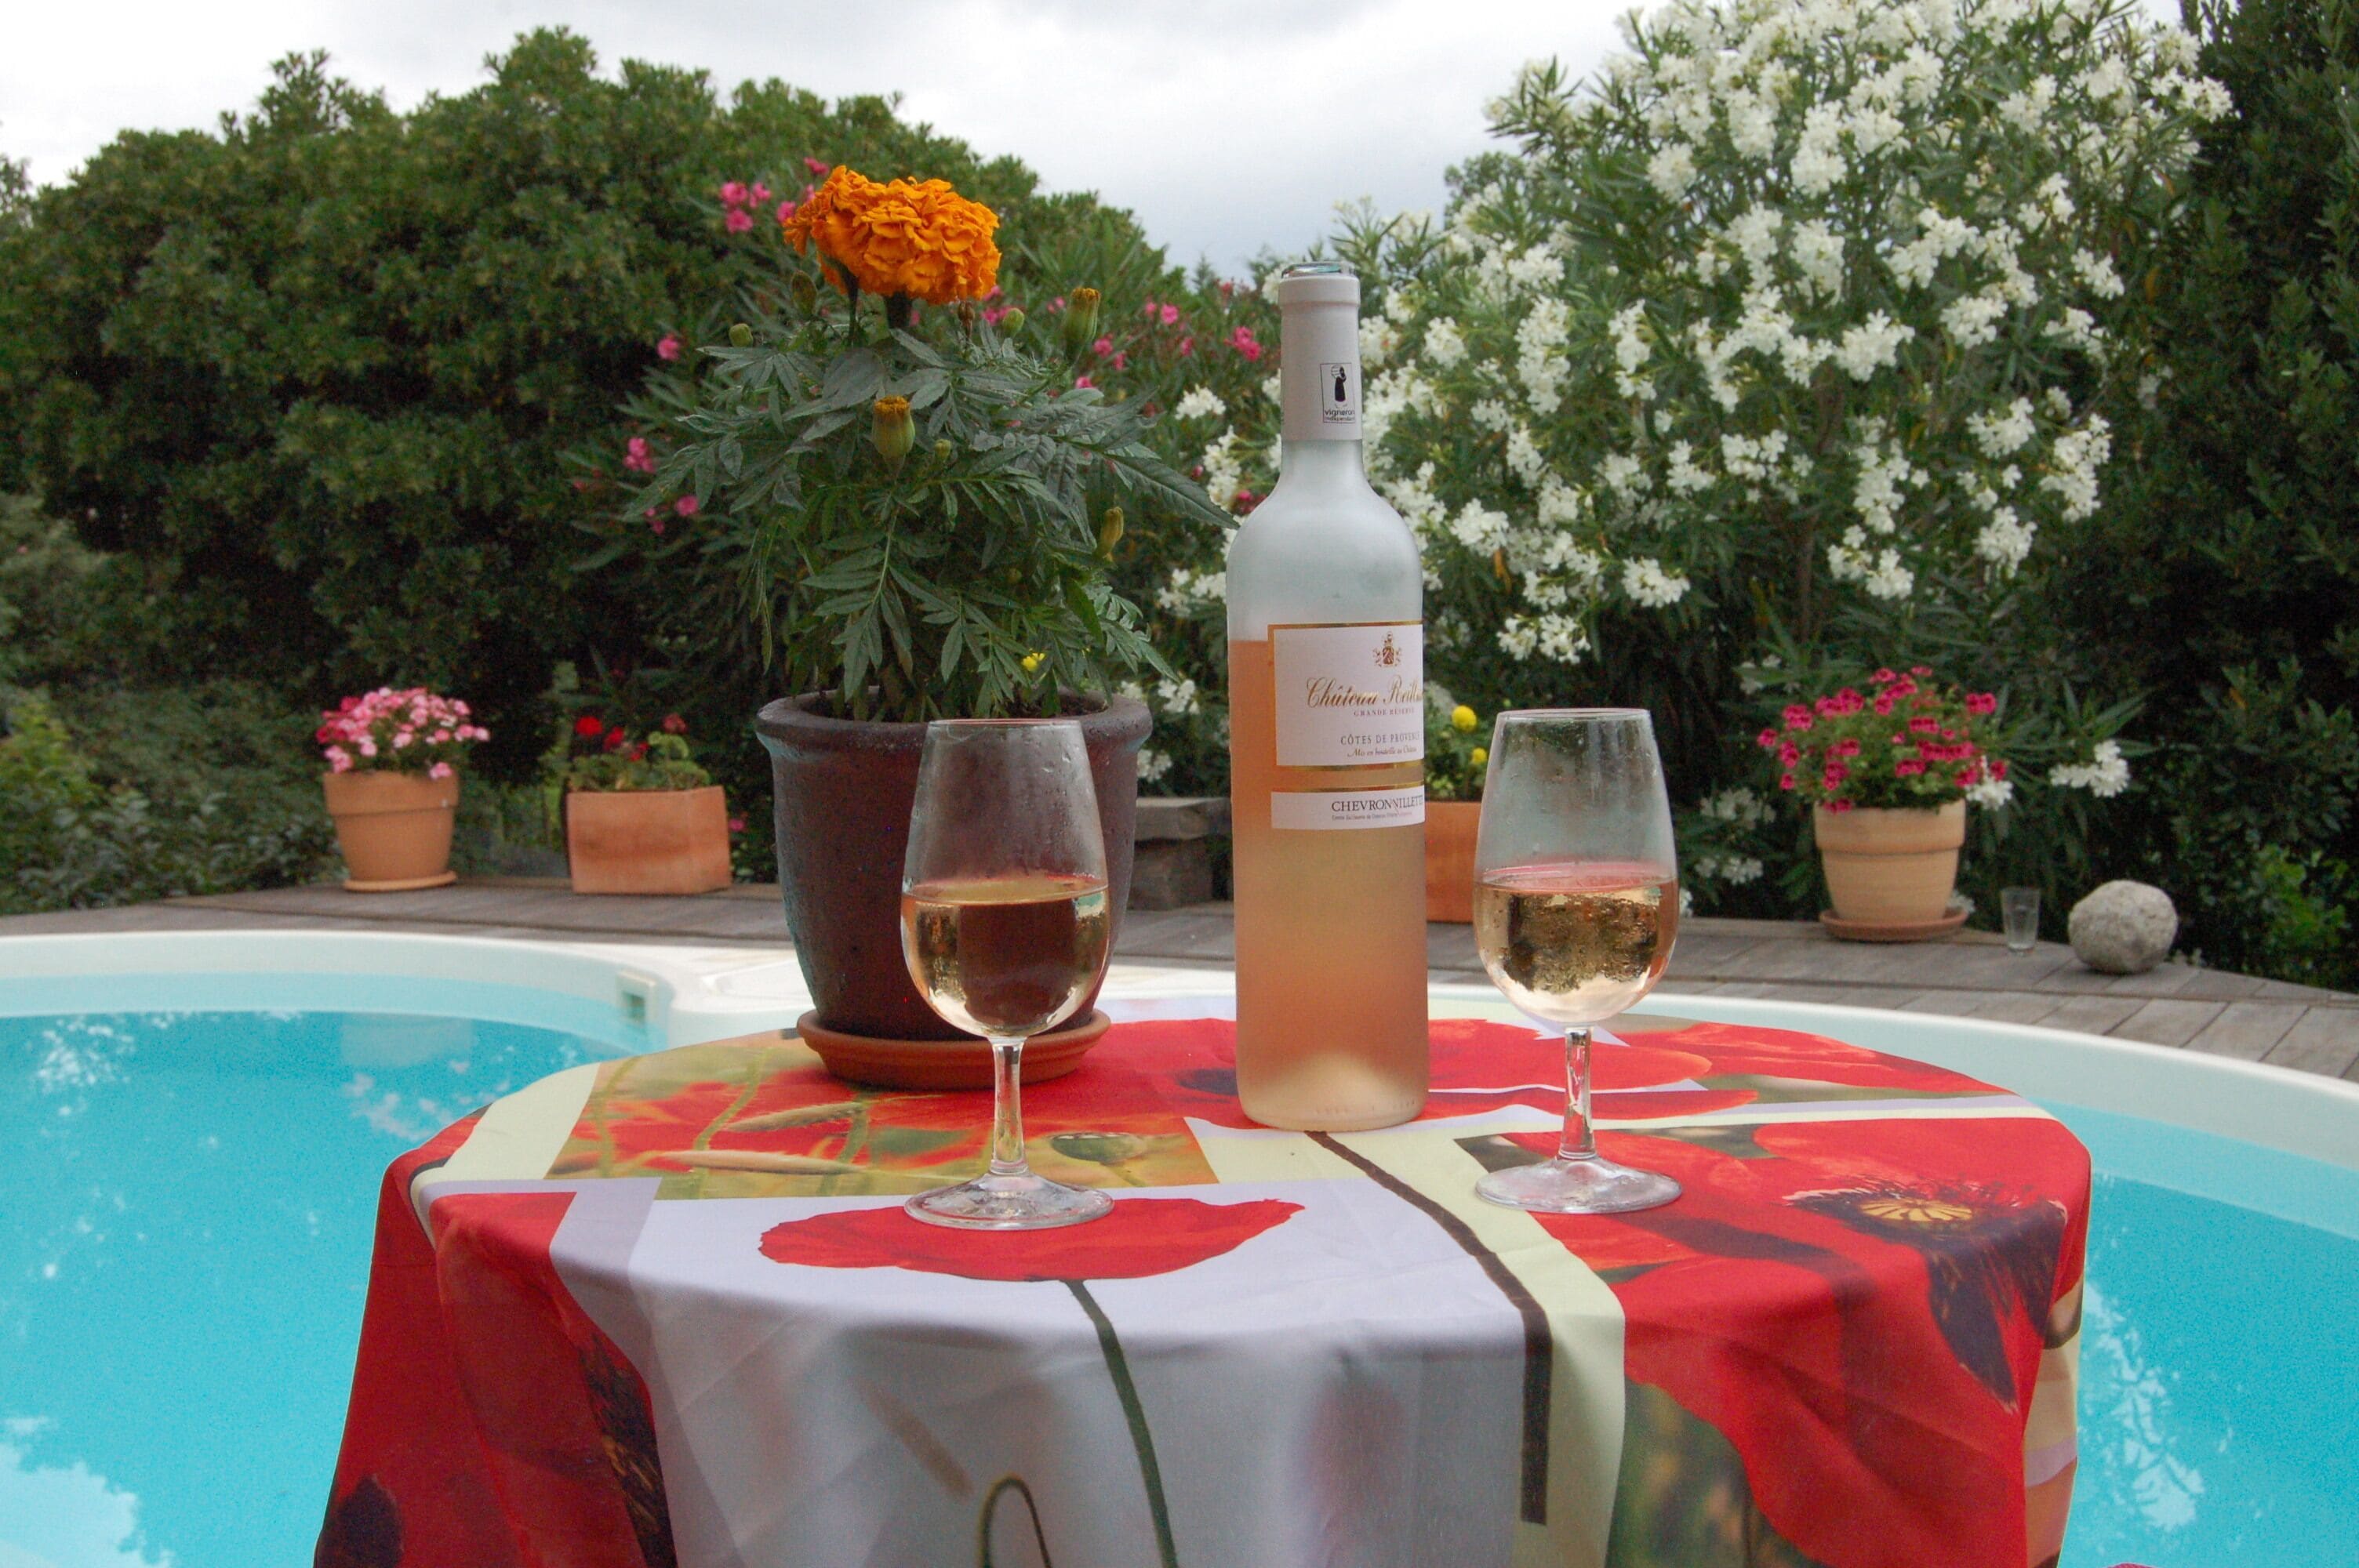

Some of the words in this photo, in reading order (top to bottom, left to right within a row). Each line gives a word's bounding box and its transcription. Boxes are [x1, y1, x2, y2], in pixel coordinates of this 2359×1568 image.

[1306, 677, 1378, 707] Château
[1353, 708, 1387, 717] GRANDE
[1340, 733, 1372, 746] CÔTES
[1376, 734, 1387, 744] DE
